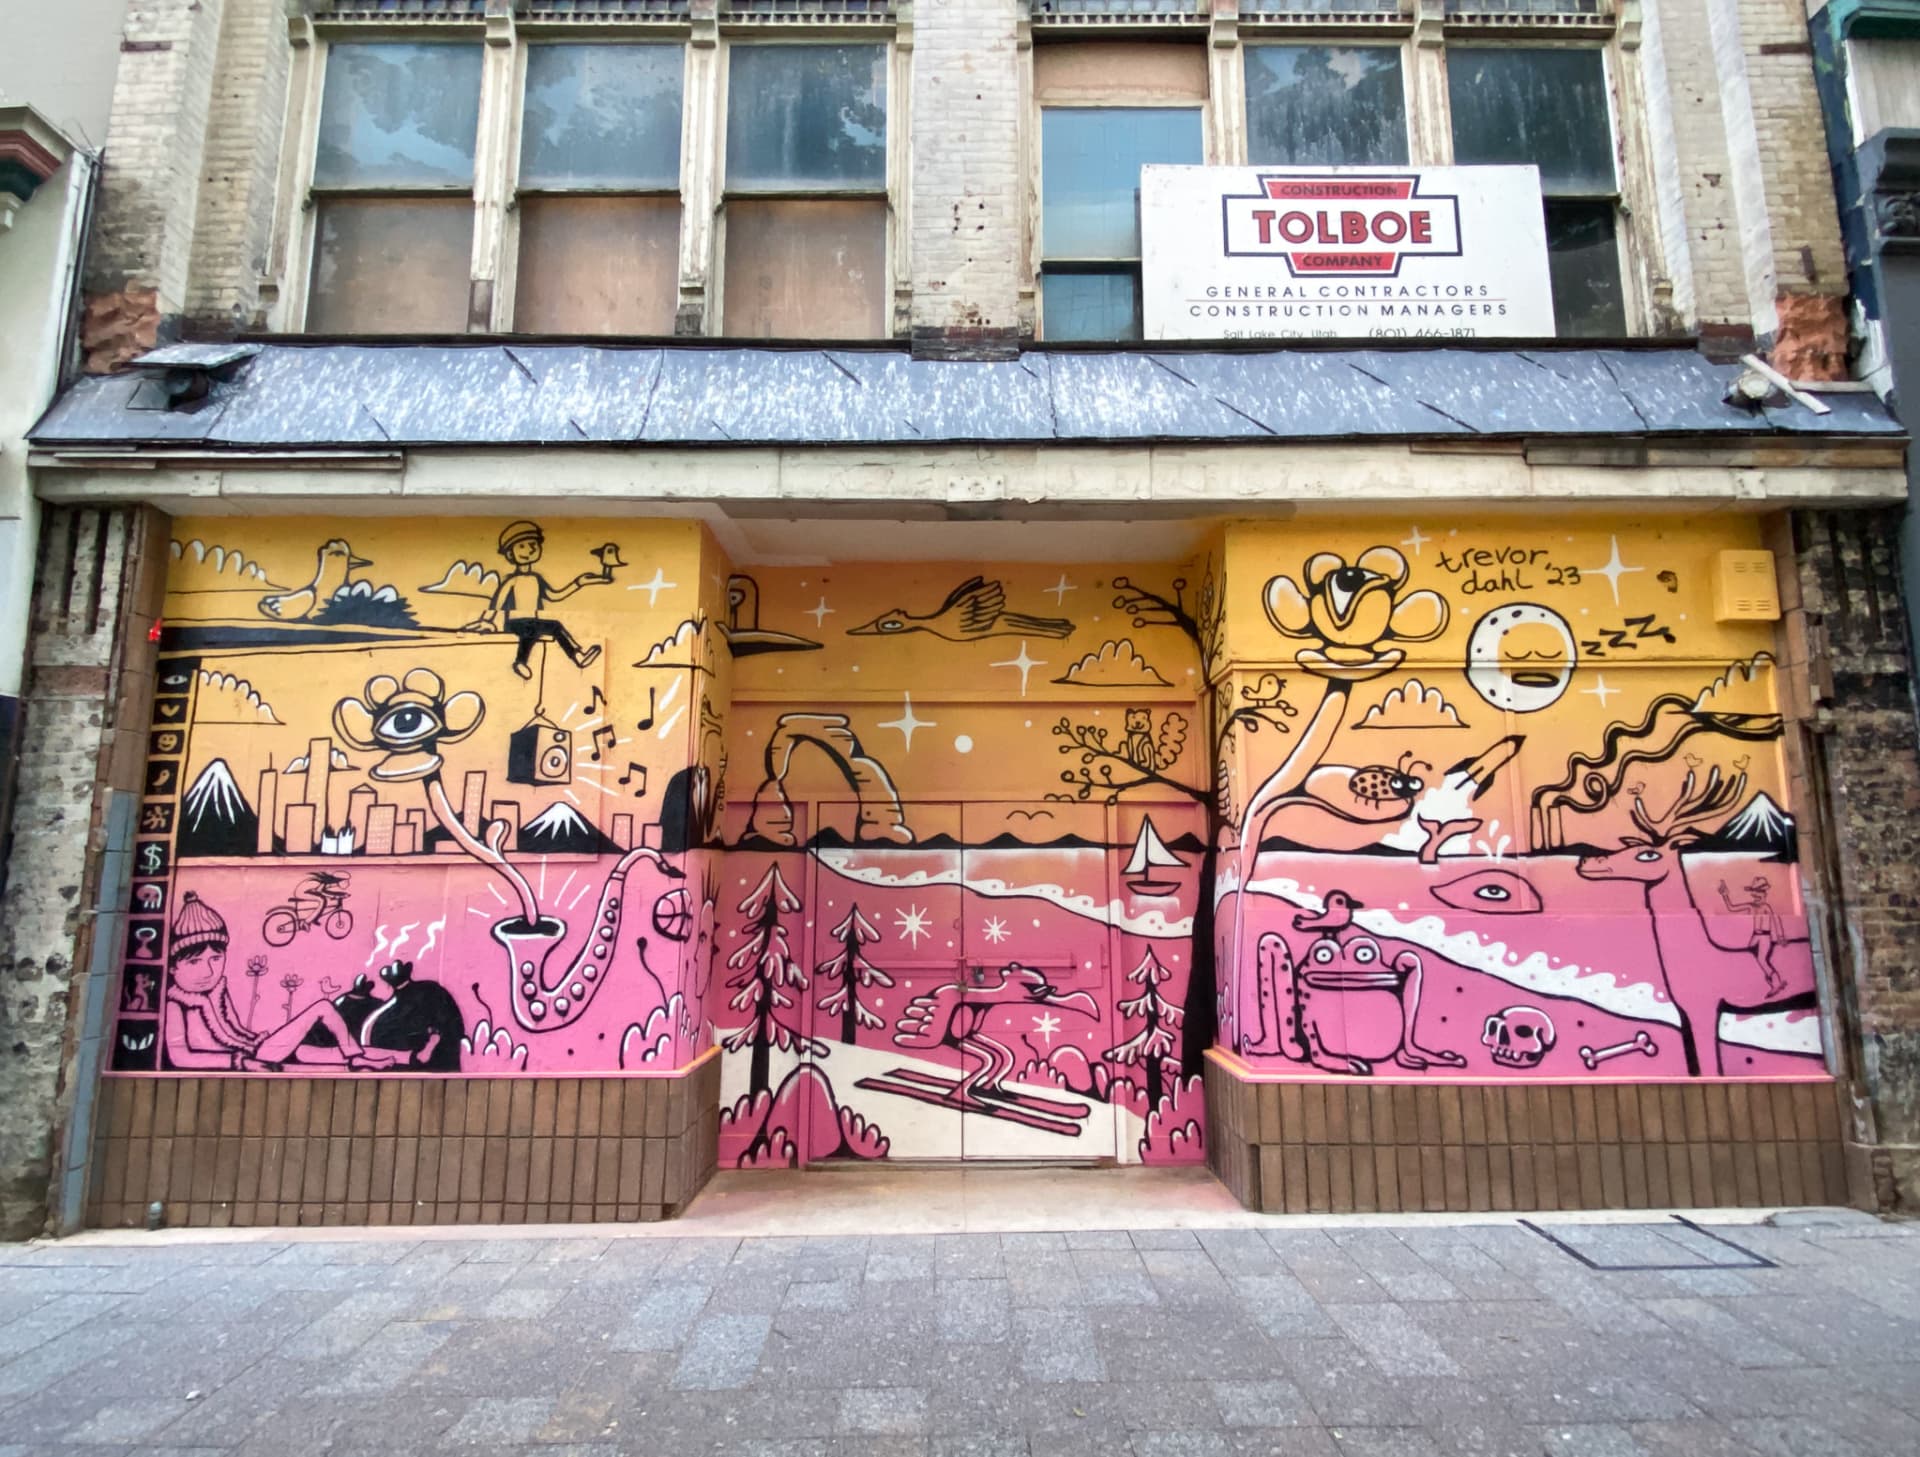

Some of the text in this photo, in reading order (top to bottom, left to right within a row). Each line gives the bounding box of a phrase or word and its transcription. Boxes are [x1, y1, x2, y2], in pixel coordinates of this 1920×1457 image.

[1281, 184, 1398, 197] CONSTRUCTION
[1252, 209, 1433, 244] TOLBOE
[1302, 255, 1383, 267] COMPANY
[1206, 285, 1488, 298] GENERAL CONTRACTORS
[1190, 303, 1507, 317] CONSTRUCTION MANAGERS
[1223, 328, 1244, 339] Salt
[1249, 328, 1276, 339] Lake
[1435, 546, 1549, 573] trevor
[1461, 567, 1534, 595] dahl
